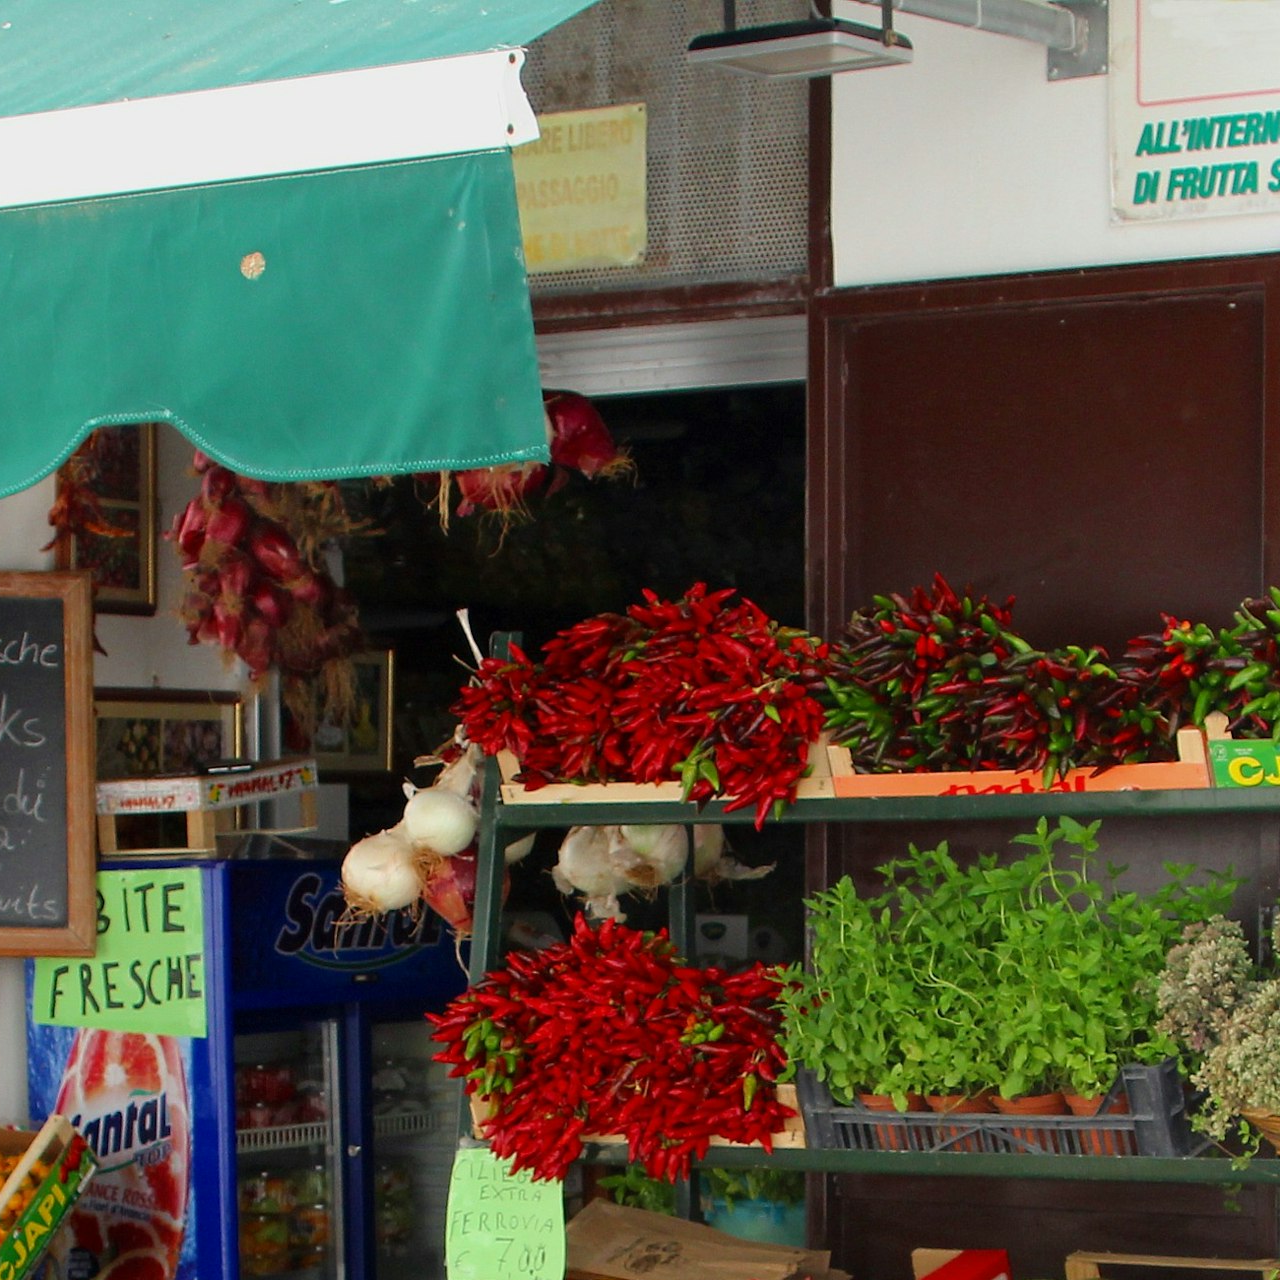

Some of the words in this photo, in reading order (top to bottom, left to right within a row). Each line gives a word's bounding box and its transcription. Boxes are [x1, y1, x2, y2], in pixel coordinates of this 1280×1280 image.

[1133, 171, 1159, 205] DI
[1165, 160, 1259, 201] FRUTTA
[3, 766, 46, 822] di
[50, 952, 203, 1019] FRESCHE
